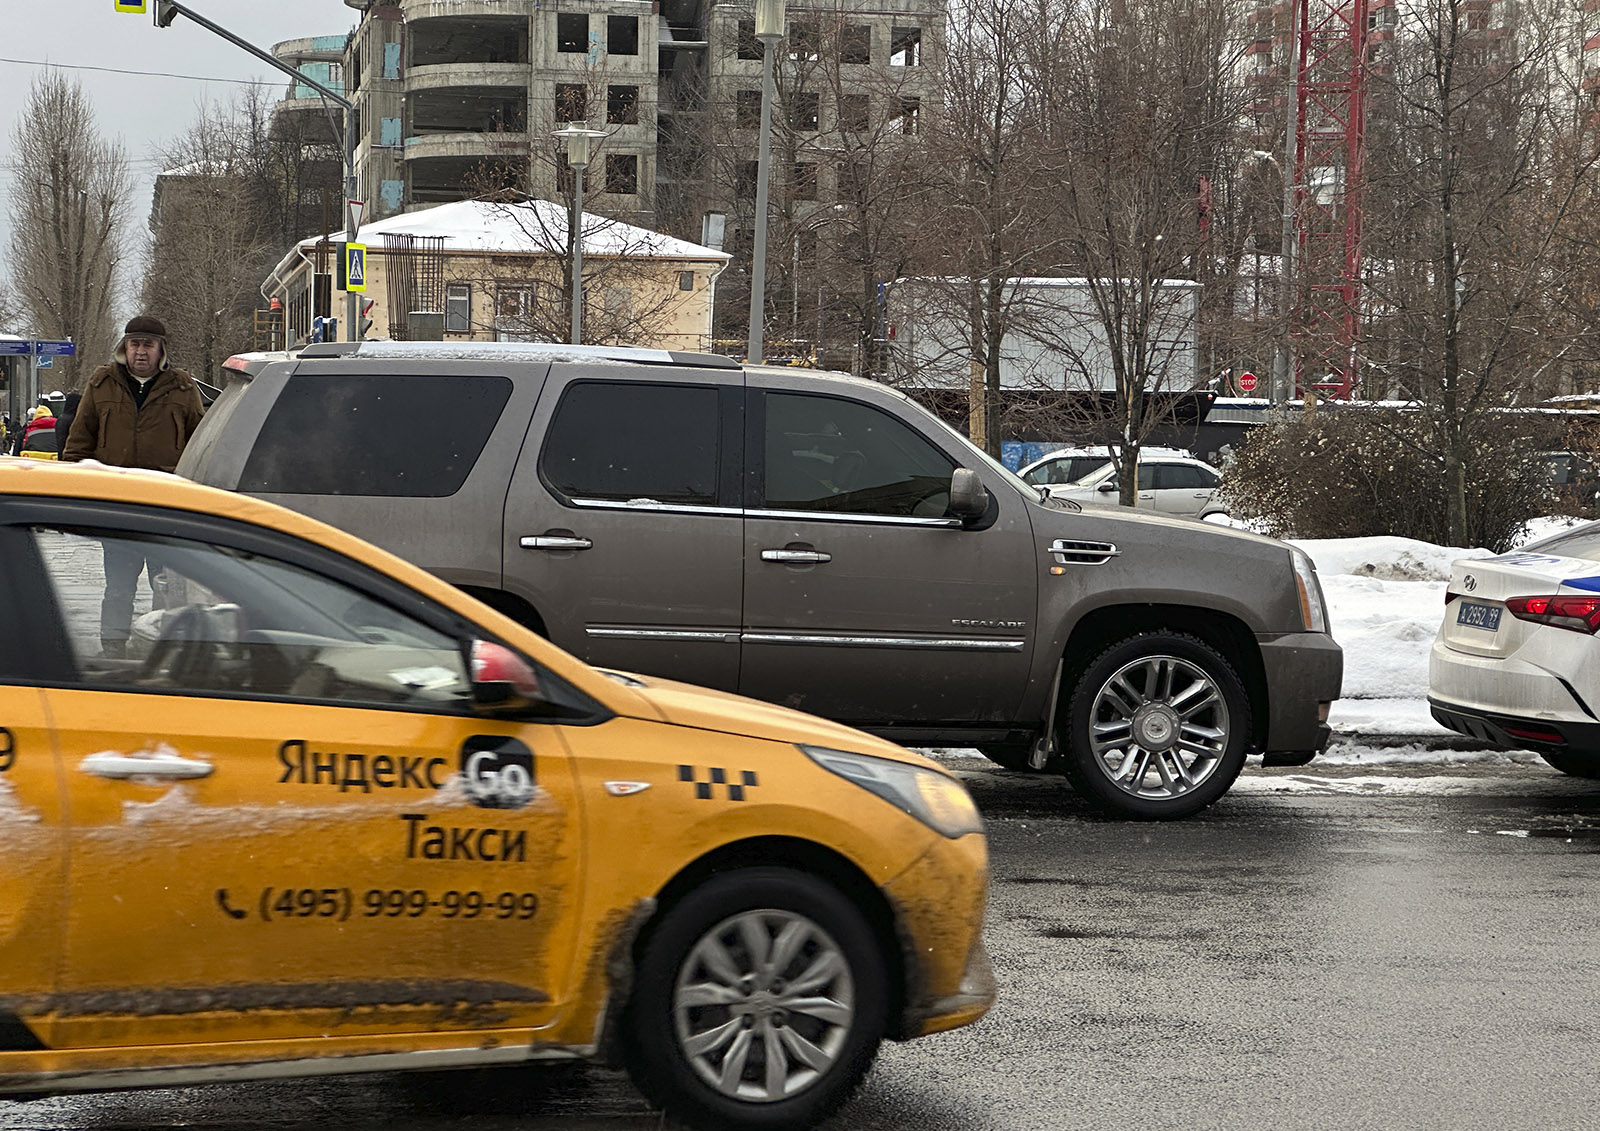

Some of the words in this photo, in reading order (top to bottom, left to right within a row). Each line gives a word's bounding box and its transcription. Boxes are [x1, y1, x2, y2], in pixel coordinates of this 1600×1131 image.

[951, 619, 1027, 628] ESCALADE
[1466, 606, 1487, 625] 2952
[1489, 608, 1499, 622] 99
[277, 739, 447, 793] Яндекс
[465, 751, 532, 797] Go
[400, 814, 527, 861] Такси
[260, 886, 352, 921] (495)
[365, 889, 538, 920] 999-99-99
